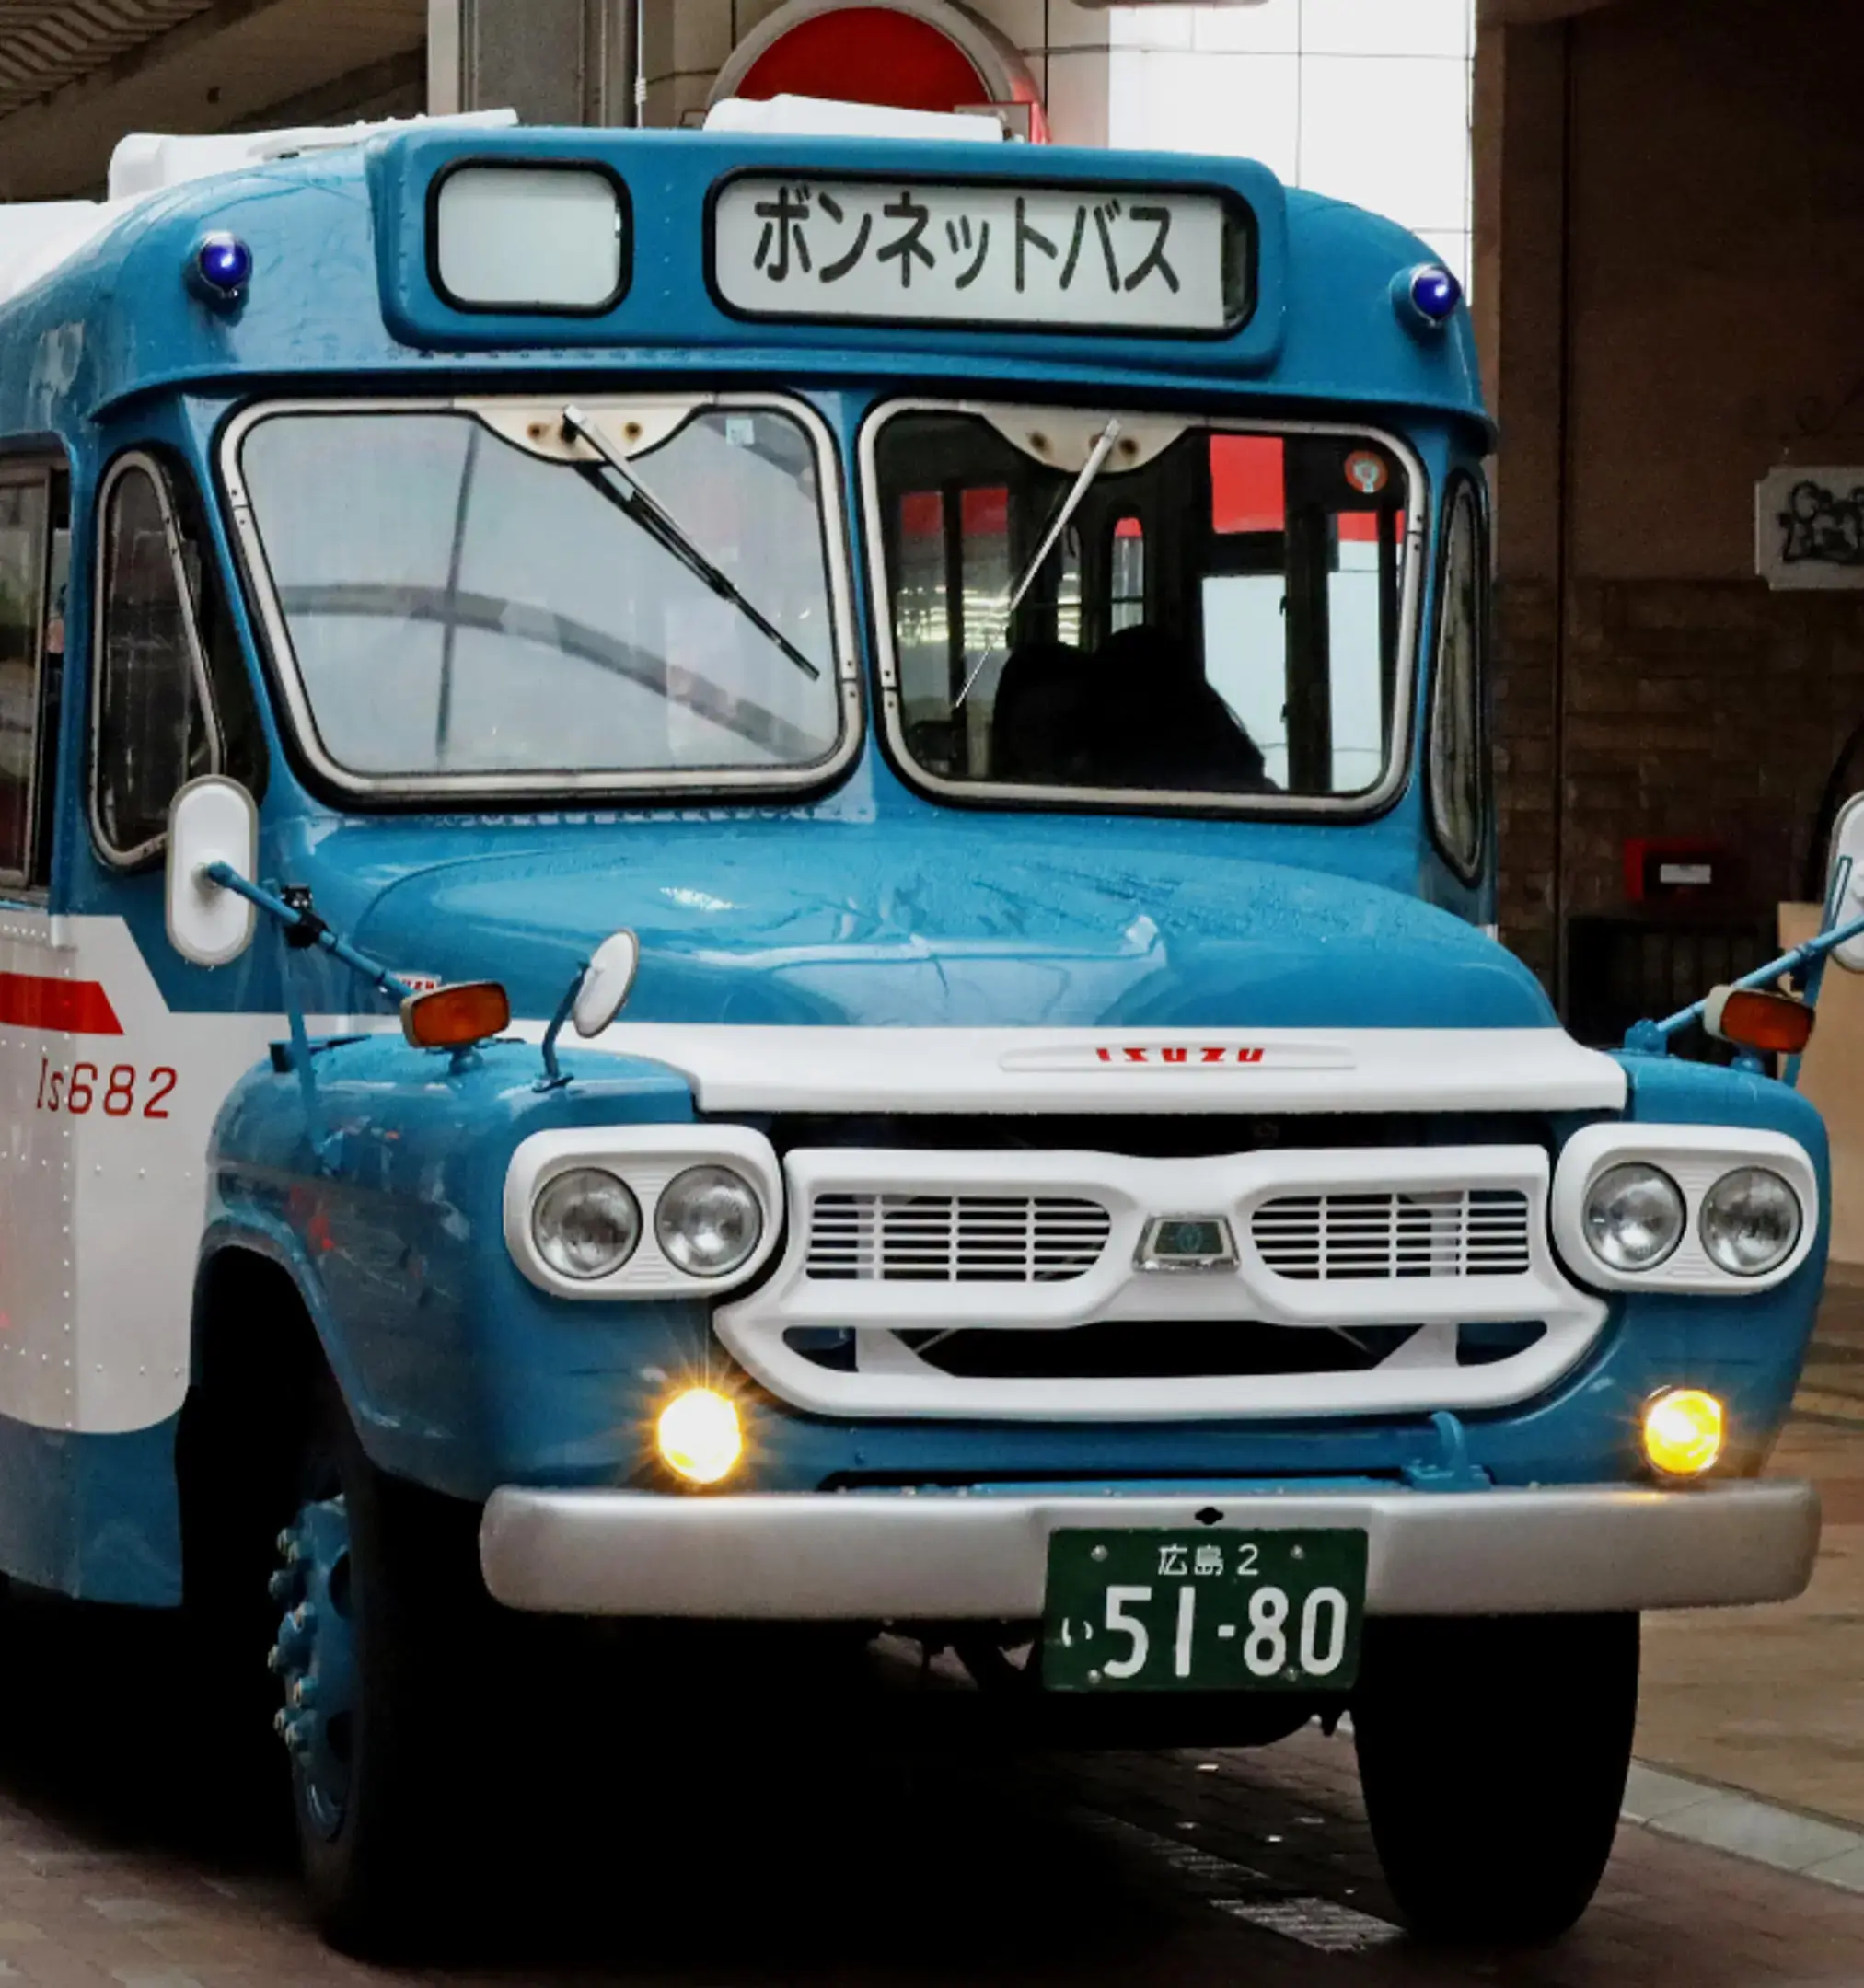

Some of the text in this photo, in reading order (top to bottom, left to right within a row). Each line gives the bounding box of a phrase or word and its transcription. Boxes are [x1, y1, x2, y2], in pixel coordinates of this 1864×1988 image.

[754, 185, 1180, 294] ボンネットバス
[1095, 1047, 1265, 1063] ISUZU
[1157, 1543, 1259, 1576] 広島 2
[1060, 1585, 1349, 1679] い 51-80
